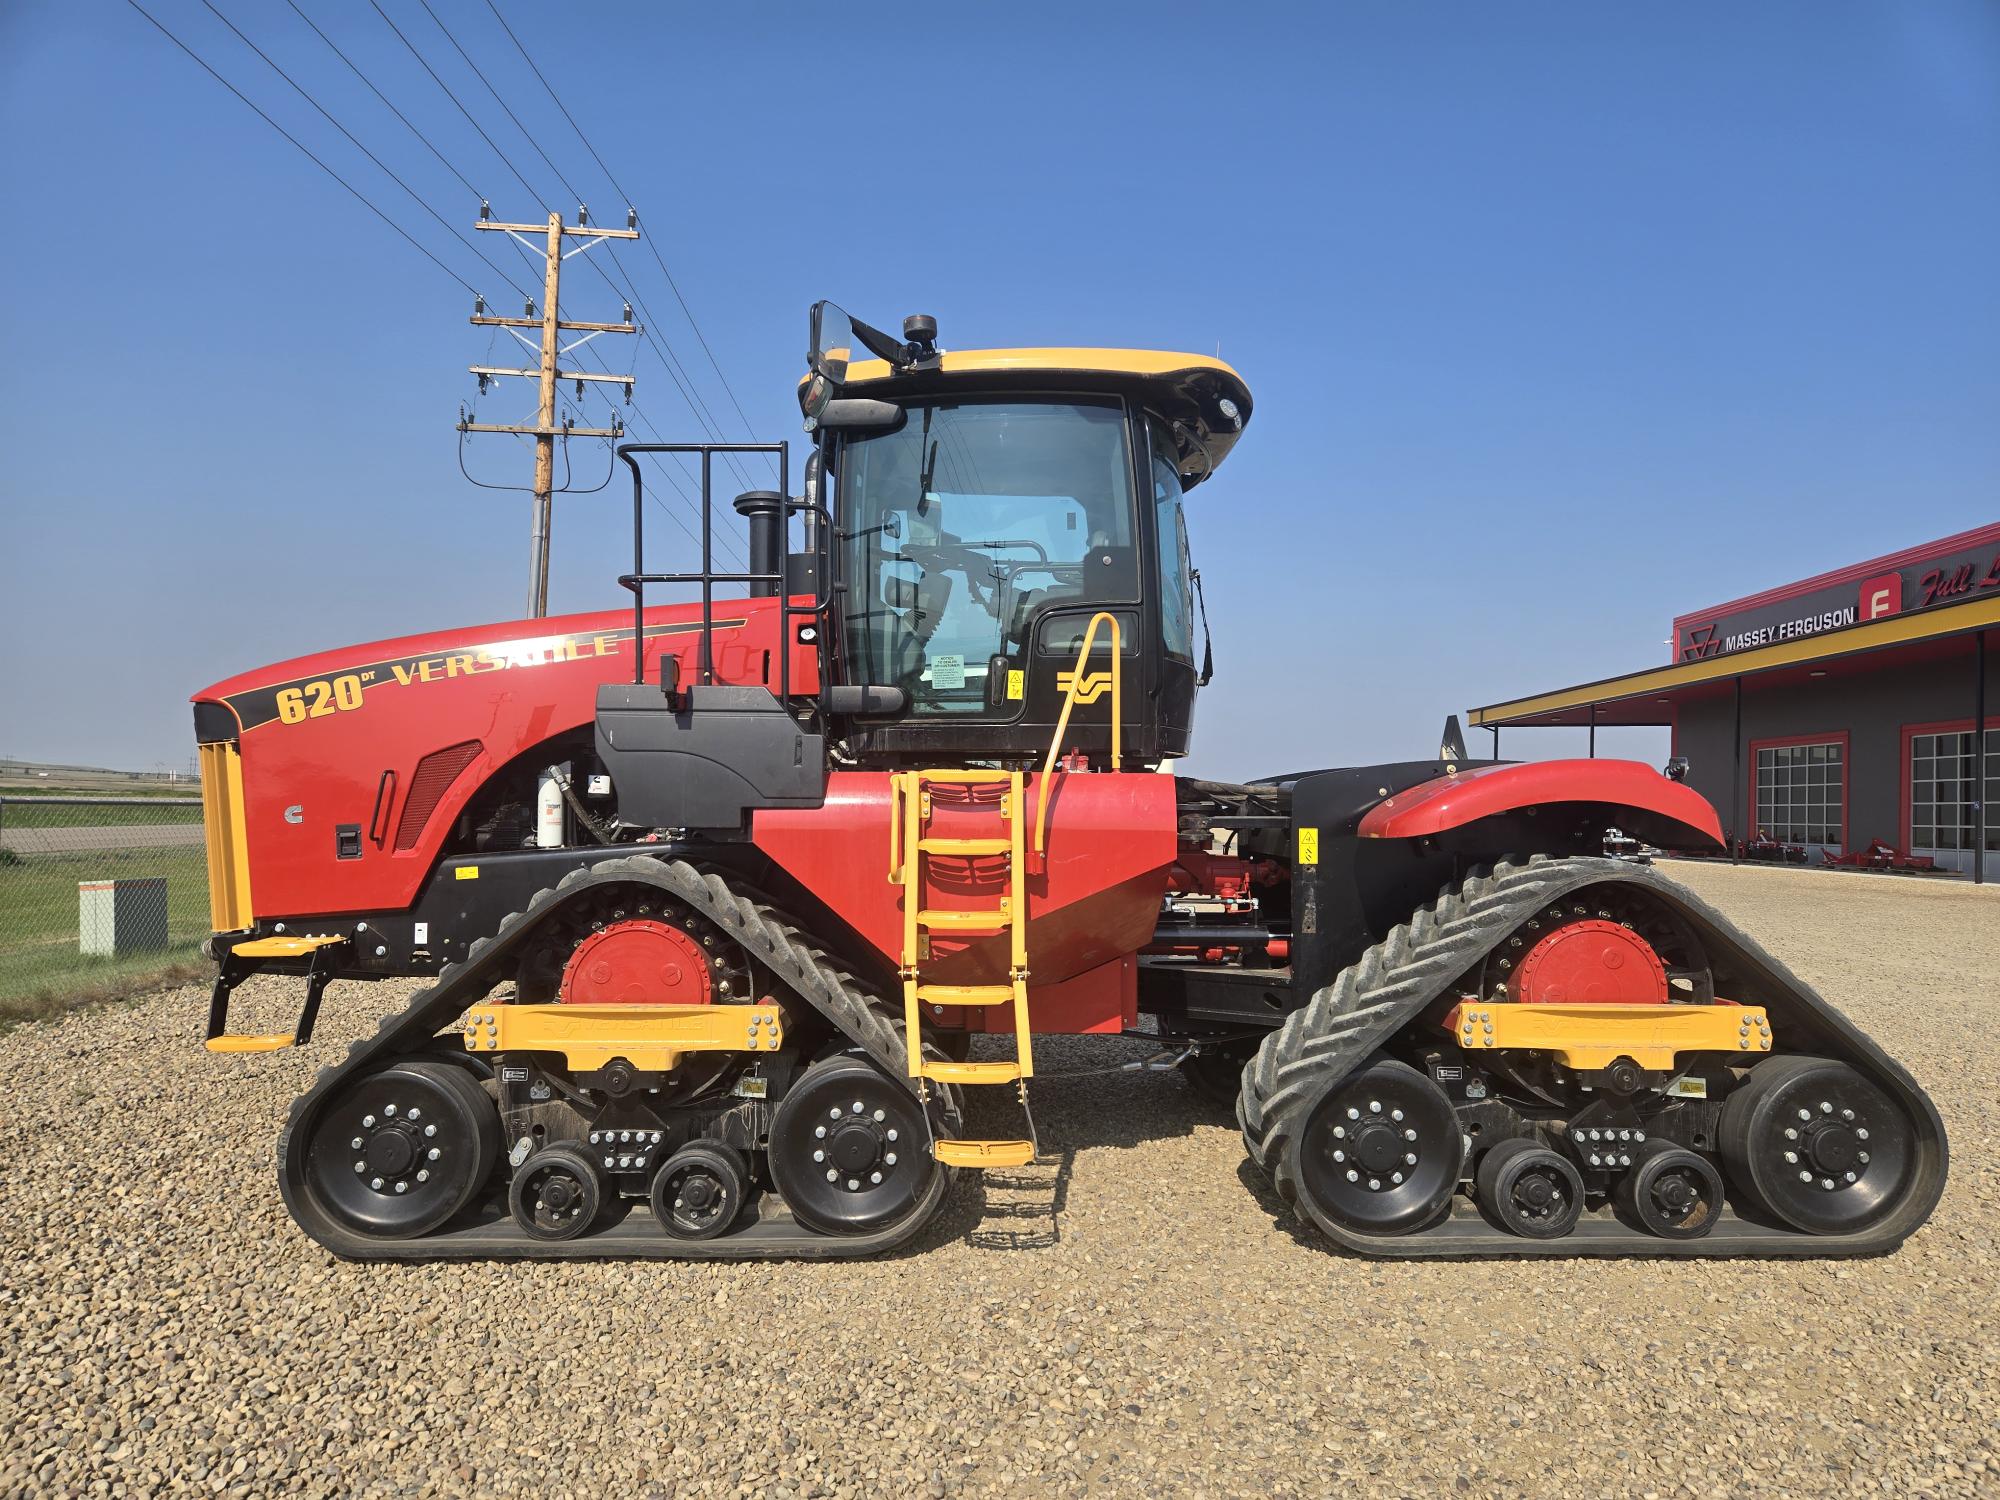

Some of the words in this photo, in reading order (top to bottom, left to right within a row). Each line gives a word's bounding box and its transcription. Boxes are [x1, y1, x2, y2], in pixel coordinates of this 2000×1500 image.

[1726, 625, 1776, 652] MASSEY
[1779, 606, 1855, 640] FERGUSON
[276, 674, 364, 725] 620
[361, 671, 376, 682] DT
[391, 634, 619, 686] VERSATILE
